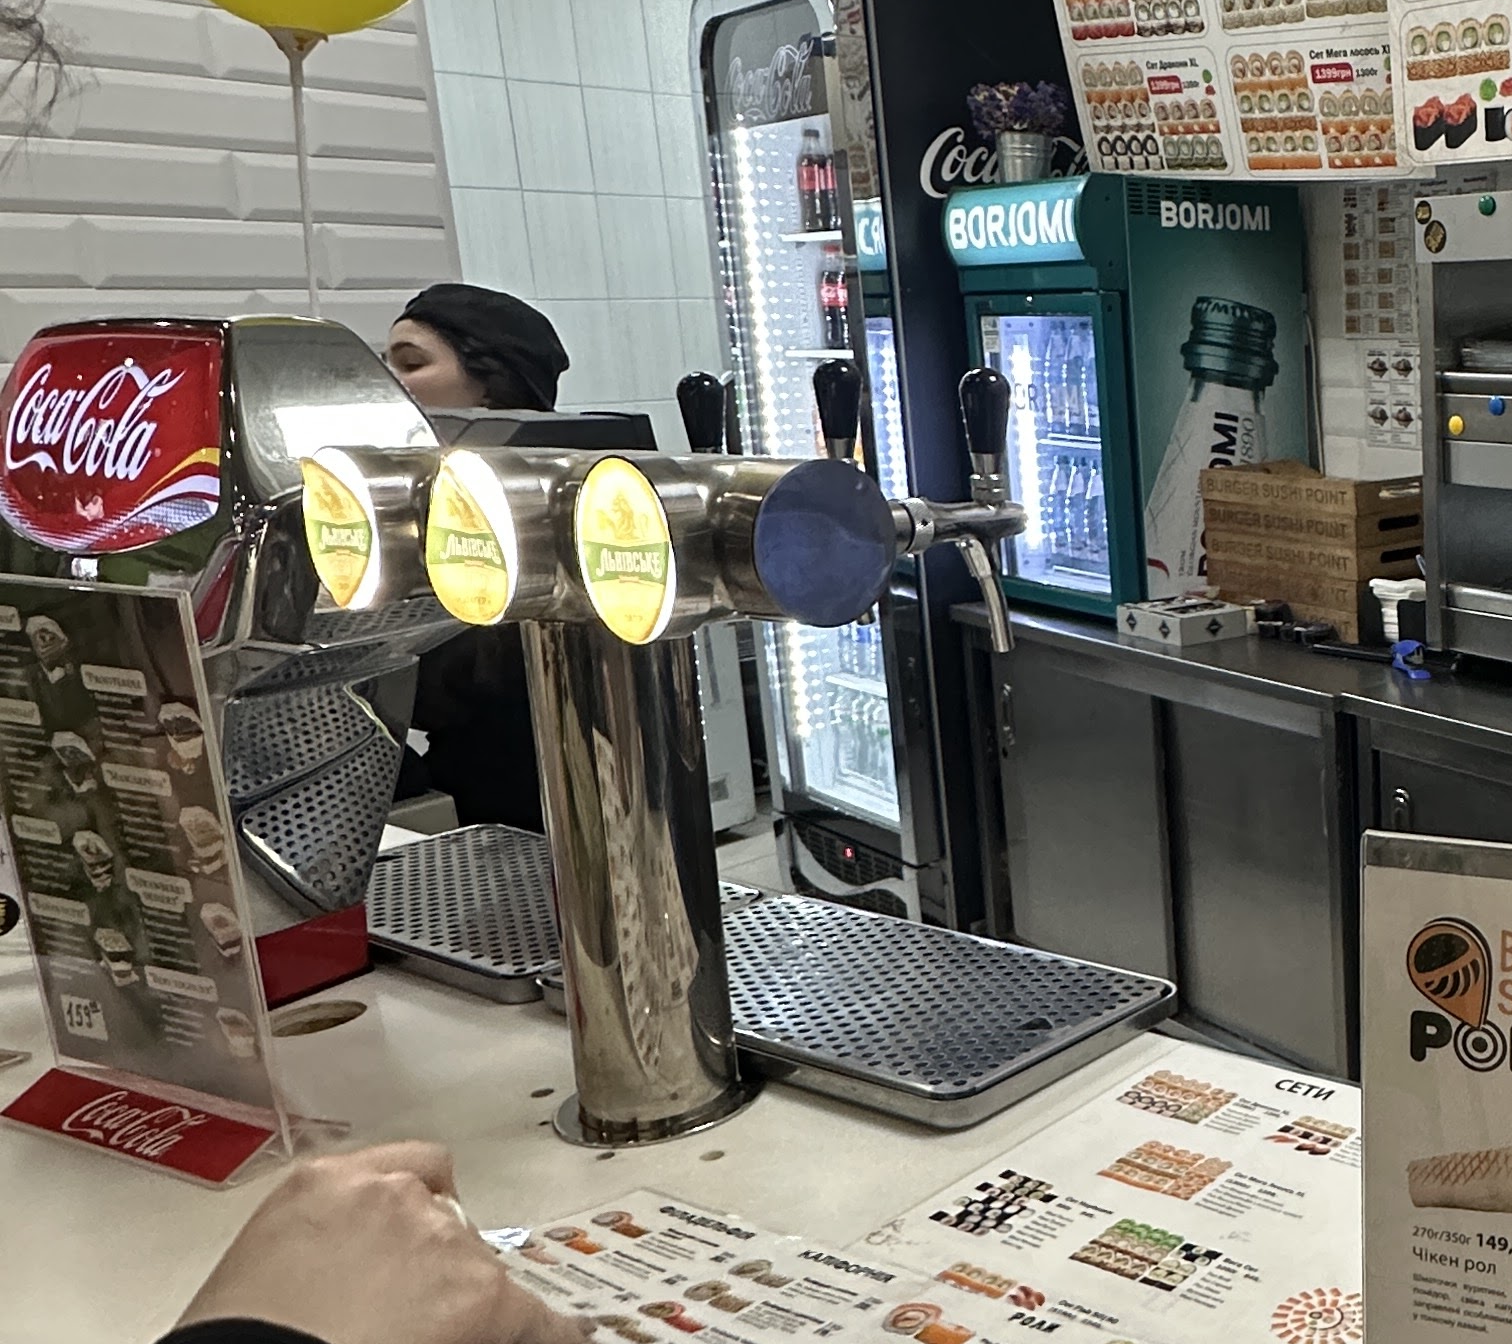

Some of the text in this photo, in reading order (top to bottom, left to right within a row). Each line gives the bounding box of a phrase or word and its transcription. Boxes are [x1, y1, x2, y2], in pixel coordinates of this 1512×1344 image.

[948, 198, 1075, 251] BORJOMI
[1160, 200, 1271, 231] BORJOMI
[1206, 478, 1260, 497] BURGER
[1306, 487, 1348, 505] POINT
[1274, 1078, 1336, 1102] СЕТИ
[1412, 1245, 1497, 1278] Чікен рол
